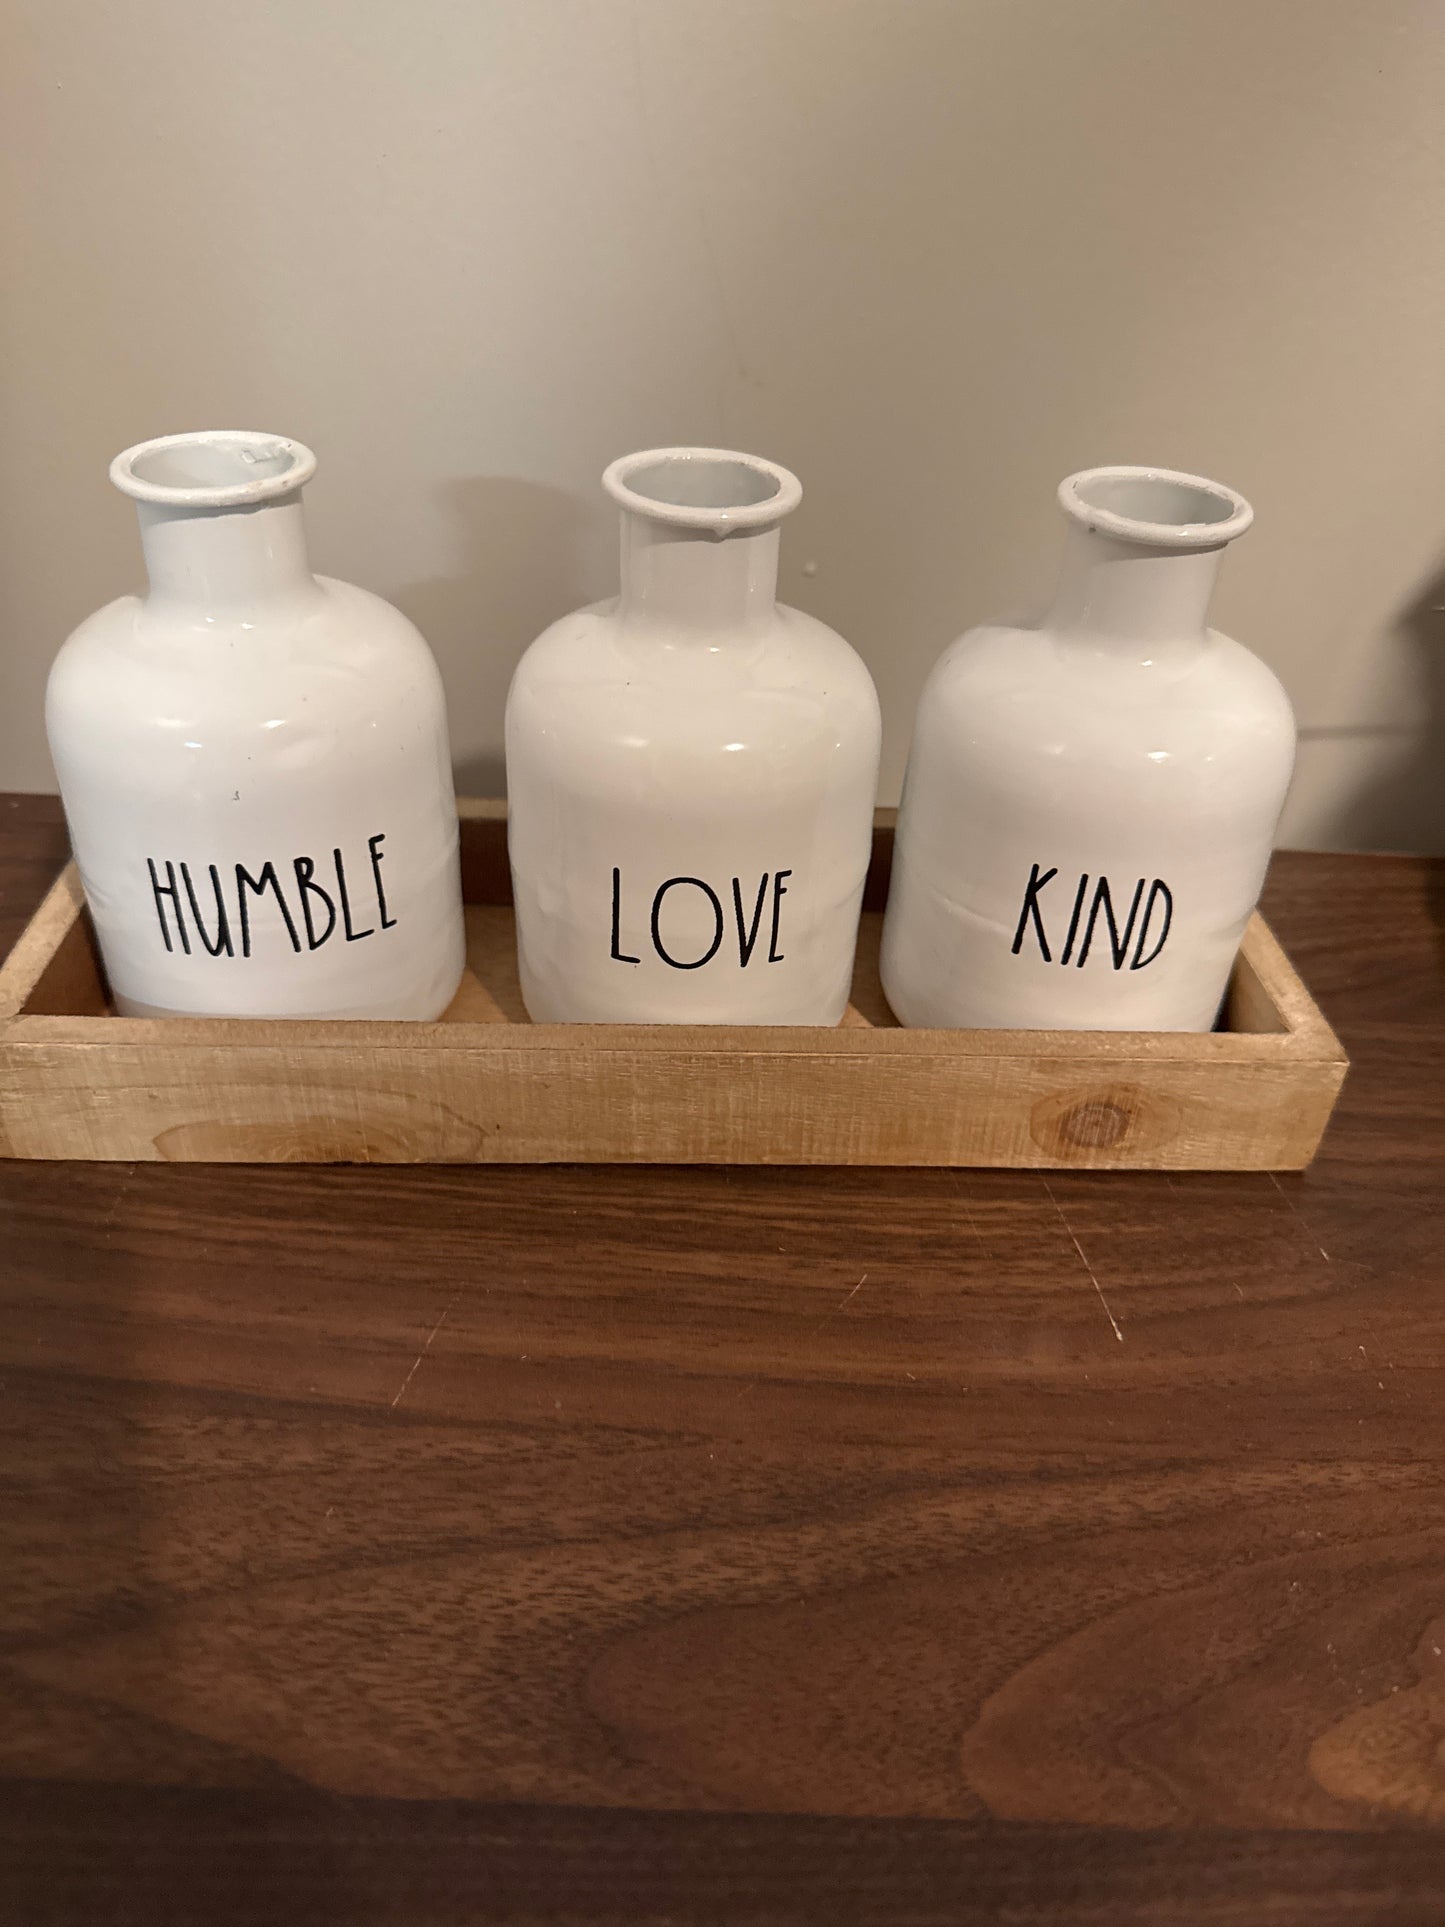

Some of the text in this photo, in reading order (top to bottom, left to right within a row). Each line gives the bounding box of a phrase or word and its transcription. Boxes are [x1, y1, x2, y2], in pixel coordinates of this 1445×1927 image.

[147, 834, 397, 958] HUMBLE
[610, 867, 793, 970] LOVE
[1011, 863, 1173, 971] KIND
